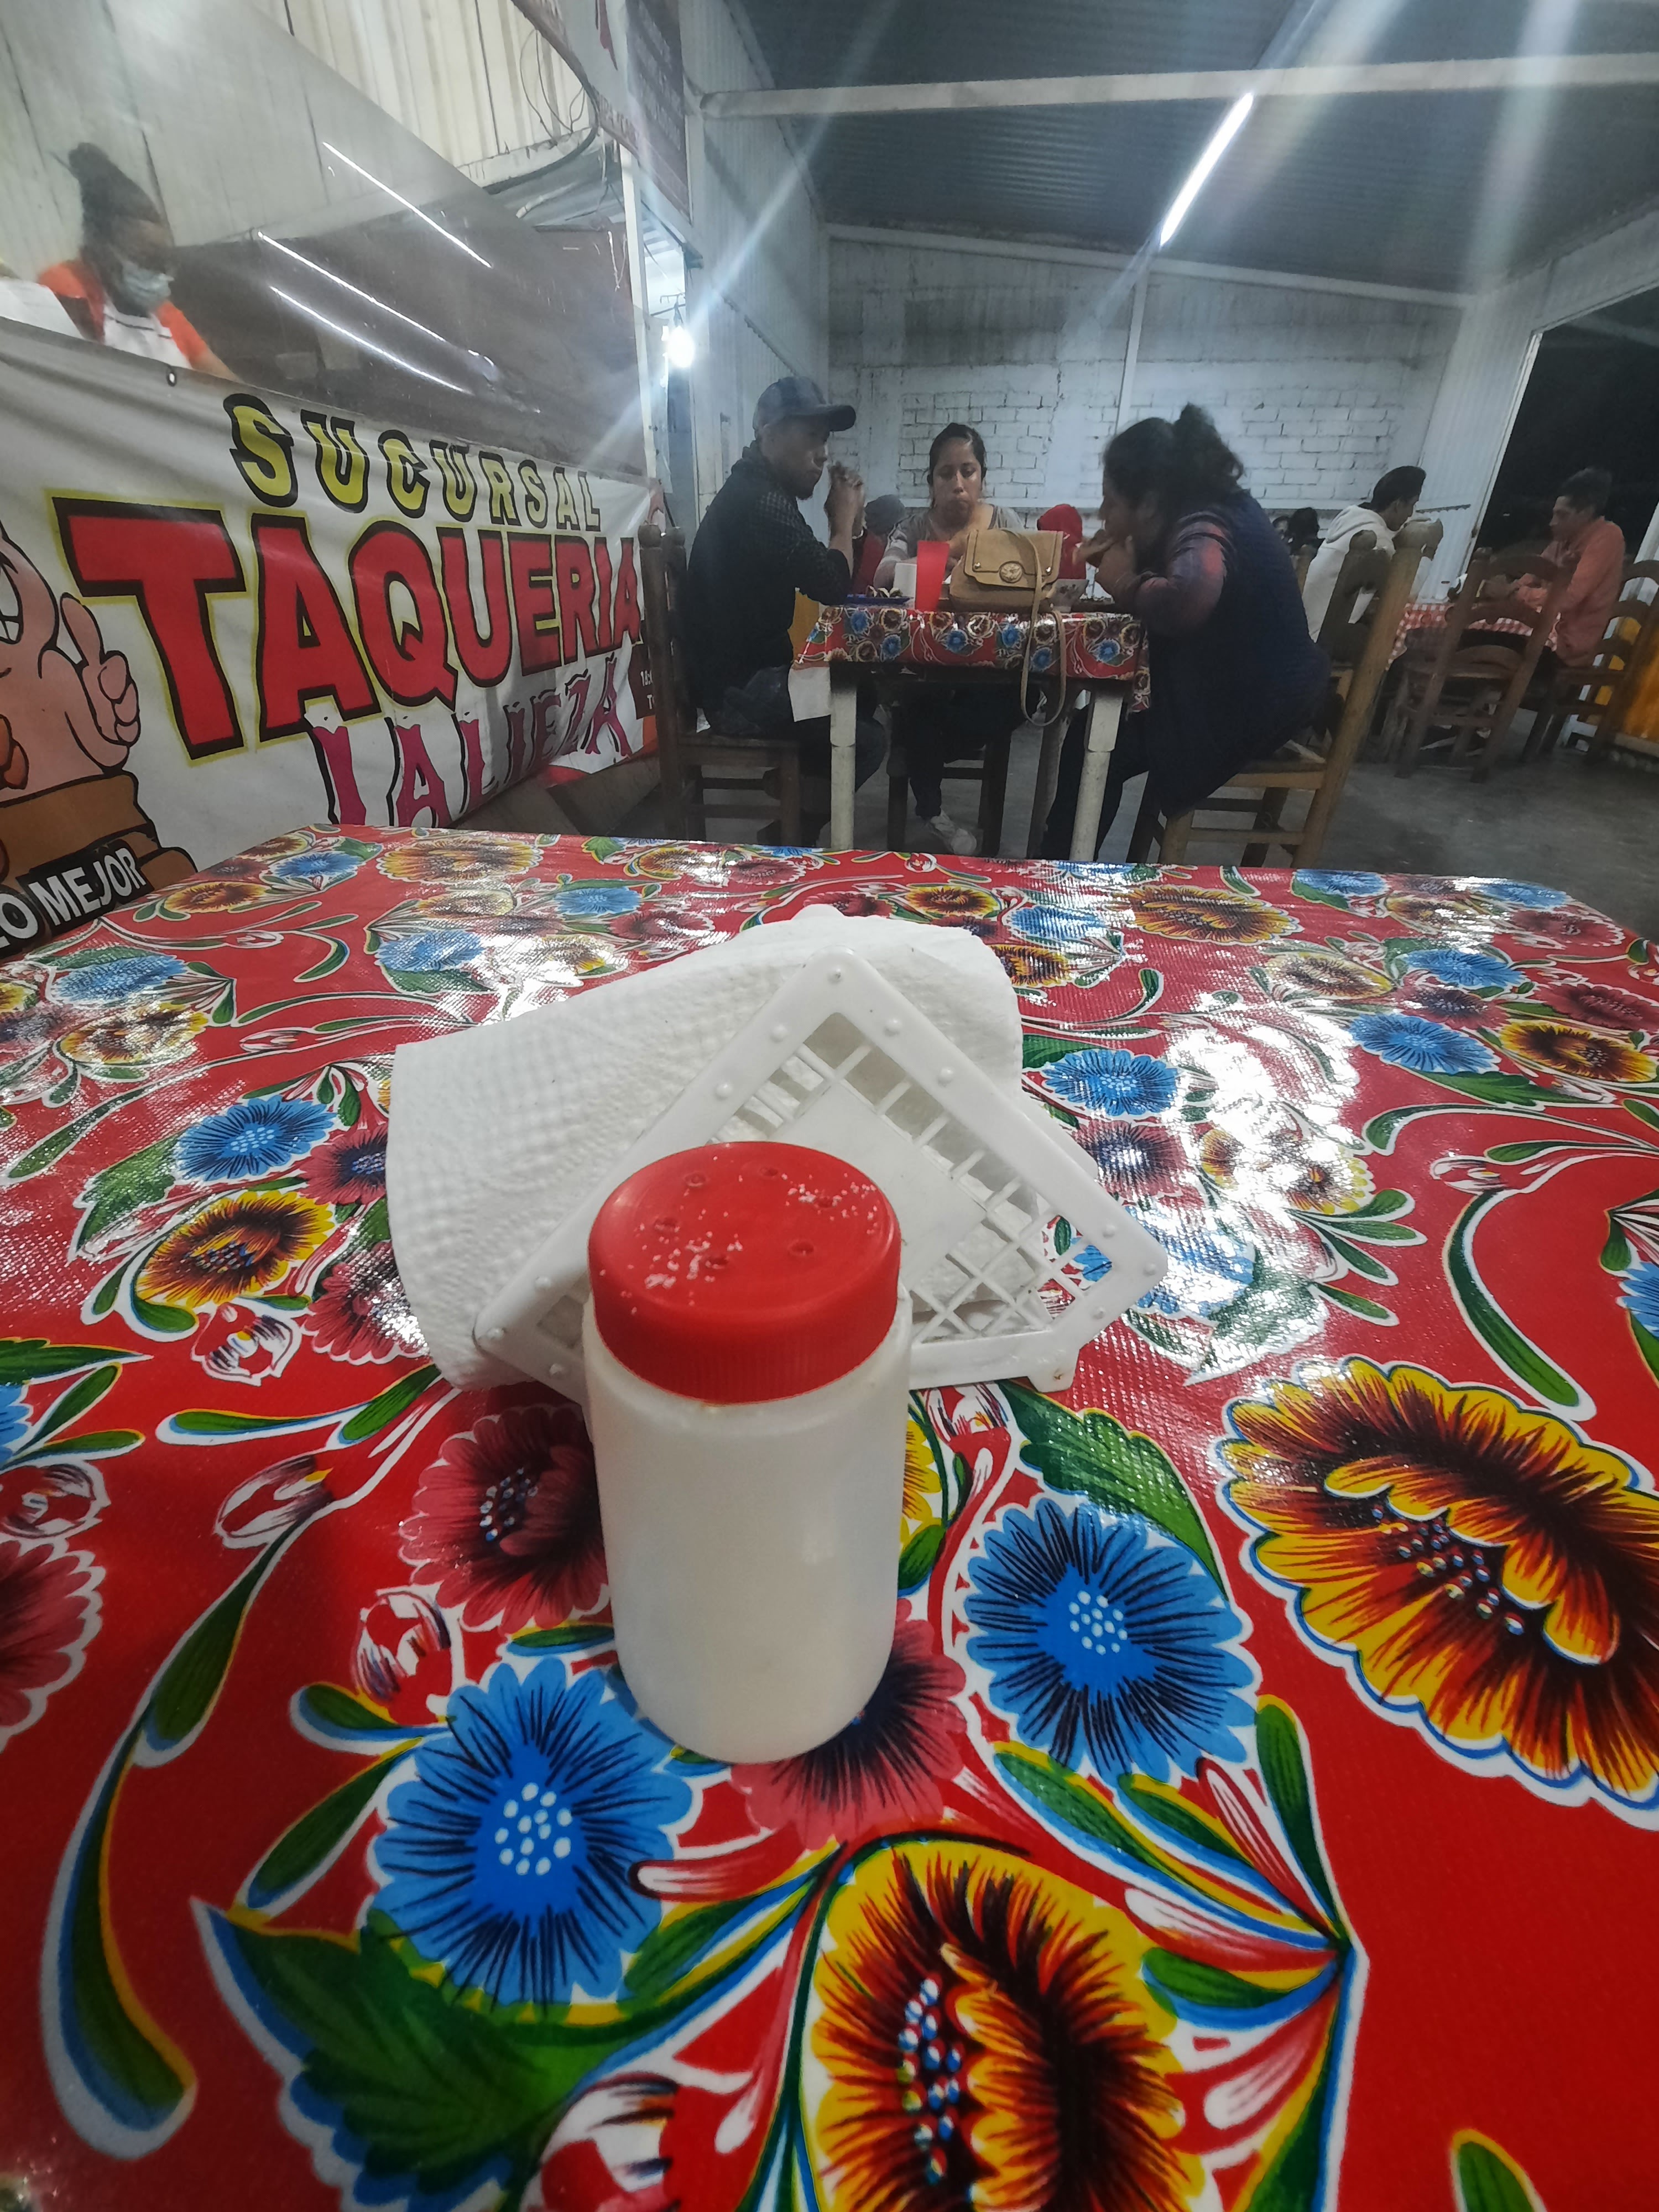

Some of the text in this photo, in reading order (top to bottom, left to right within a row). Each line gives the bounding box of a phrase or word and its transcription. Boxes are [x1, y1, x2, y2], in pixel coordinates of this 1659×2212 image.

[223, 393, 602, 532] SUCURSAL
[51, 495, 642, 760] TAQUERIA
[0, 848, 147, 948] O MEJOR
